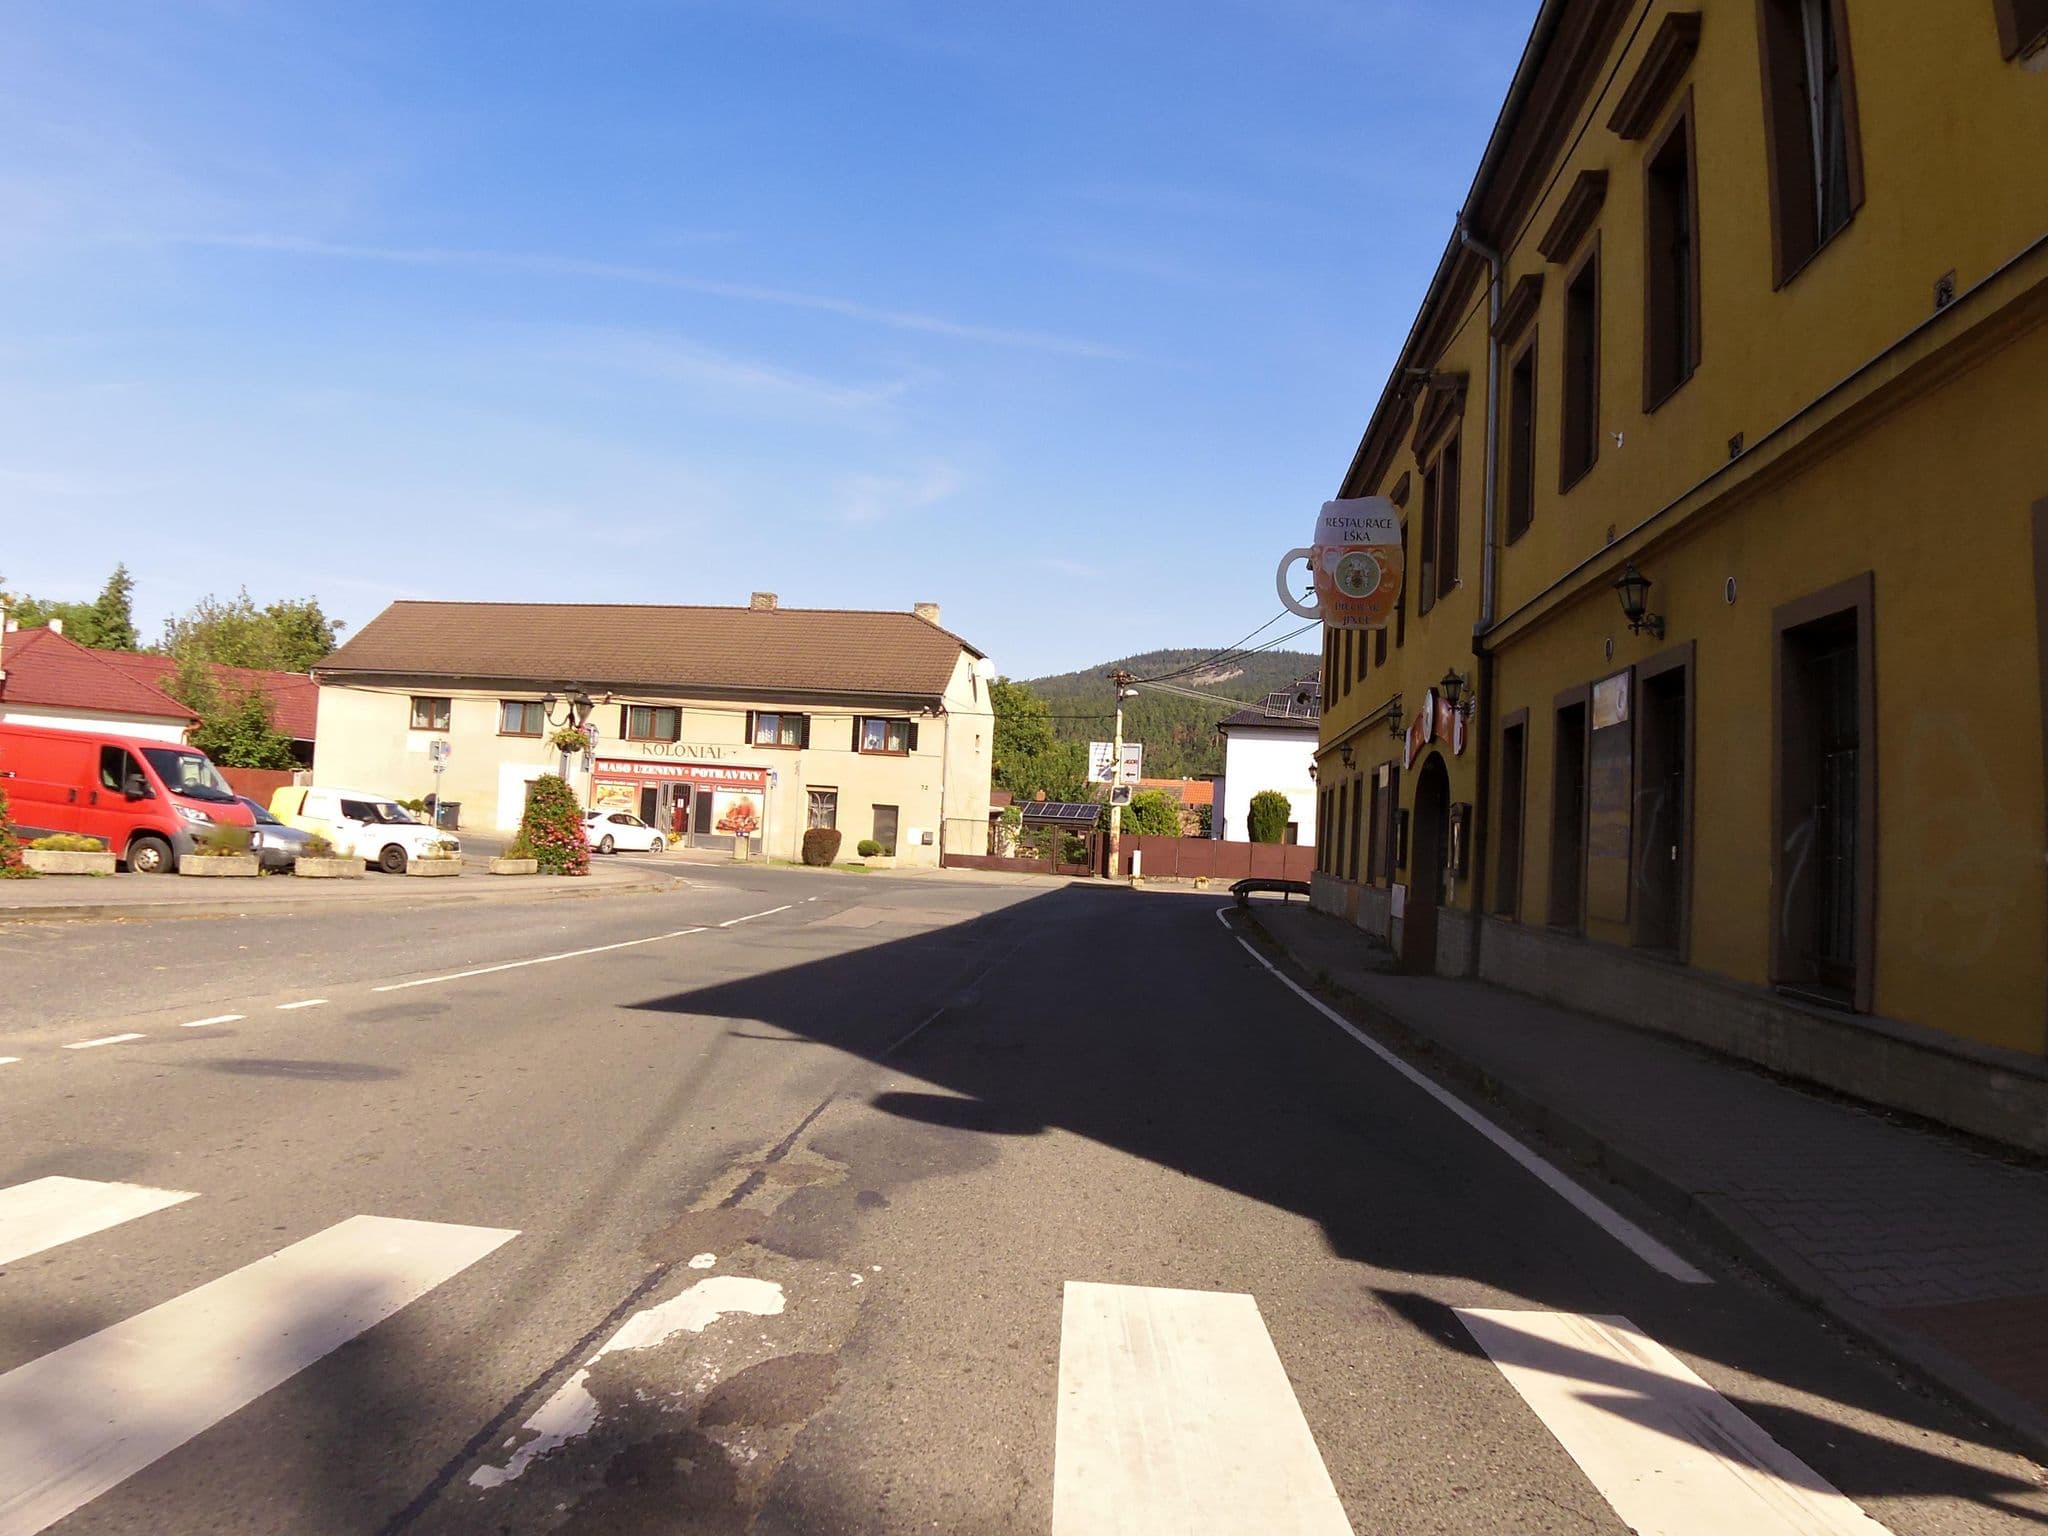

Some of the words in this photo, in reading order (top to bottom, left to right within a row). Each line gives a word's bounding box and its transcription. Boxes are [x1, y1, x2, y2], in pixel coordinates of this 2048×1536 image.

[1325, 517, 1392, 529] RESTAURACE
[642, 743, 725, 760] KOLONIÁL
[598, 762, 631, 774] MASO
[690, 767, 762, 782] POTRAVINY
